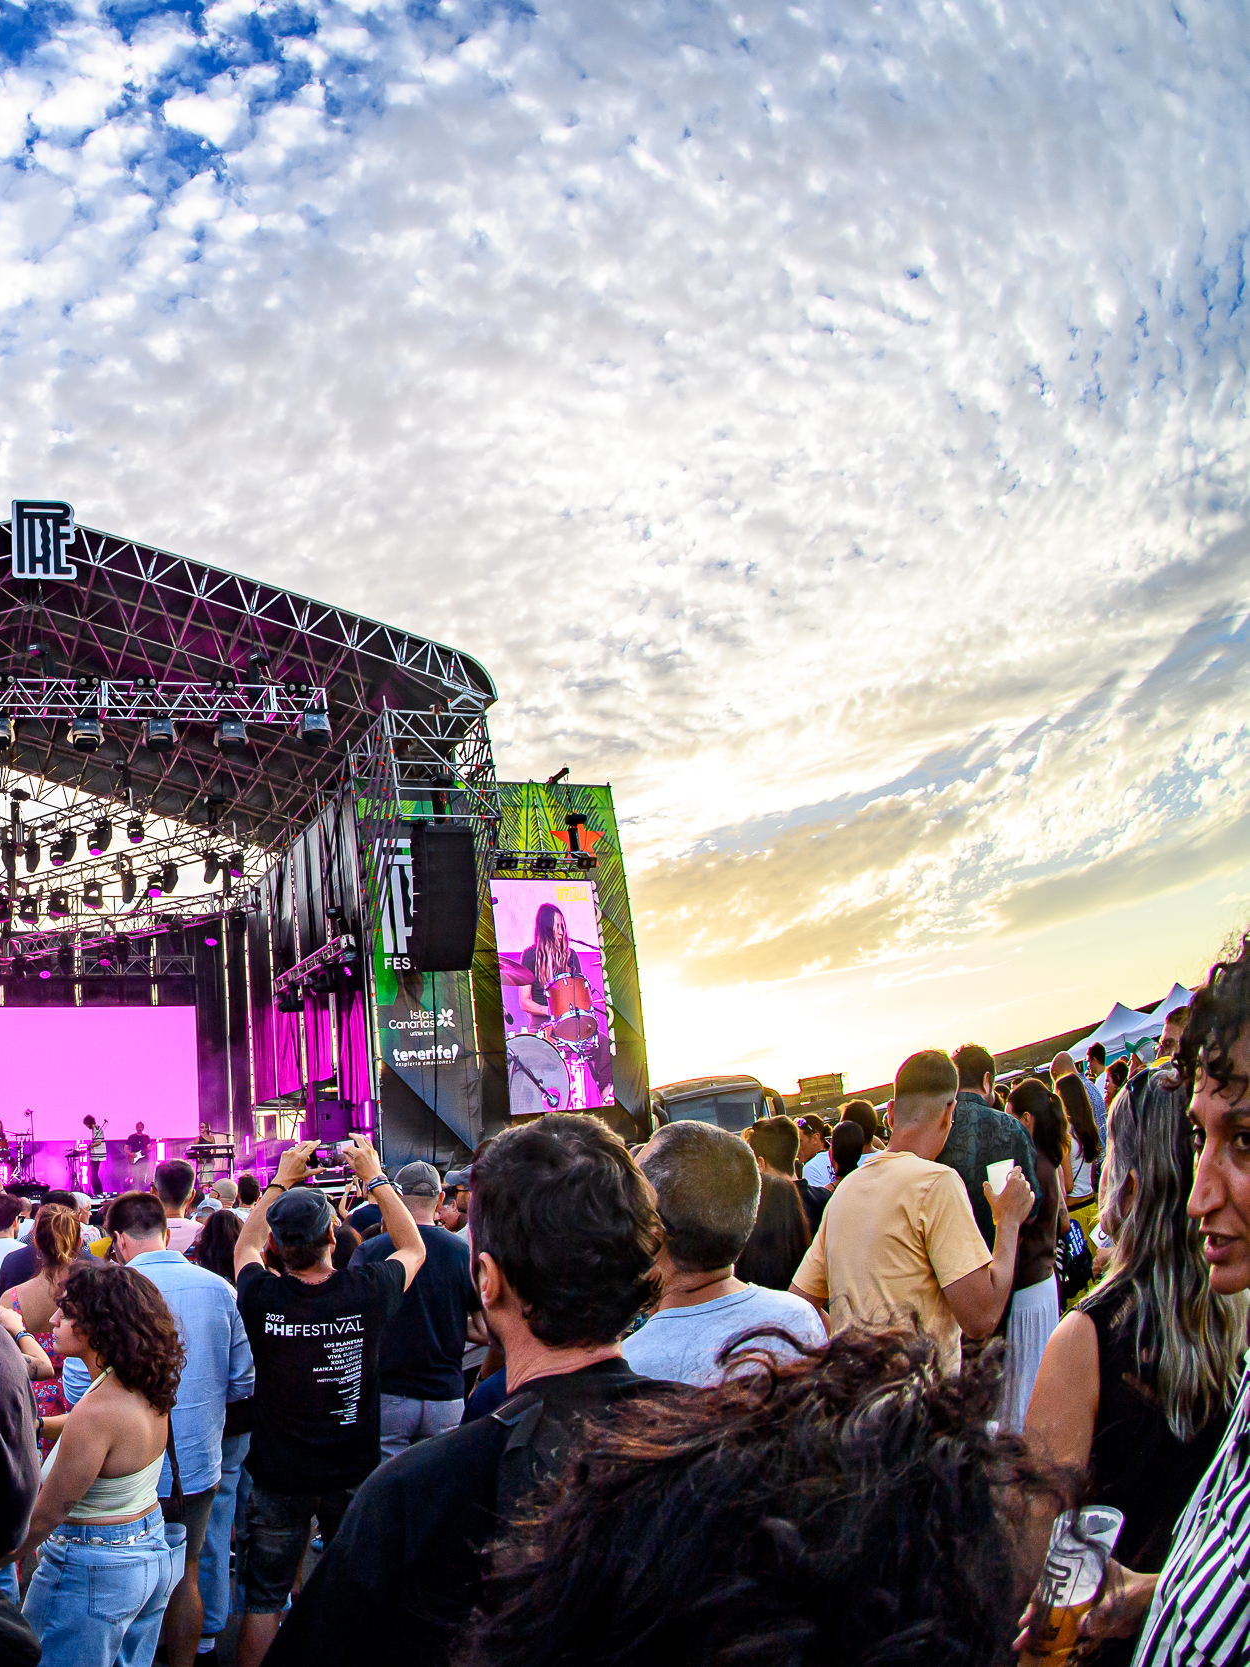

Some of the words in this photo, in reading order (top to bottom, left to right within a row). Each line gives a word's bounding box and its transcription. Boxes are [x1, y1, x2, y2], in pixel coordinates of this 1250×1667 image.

[410, 1009, 435, 1020] Islas
[388, 1019, 436, 1030] Canarias
[265, 1313, 285, 1323] 2022
[264, 1320, 365, 1336] PHEFESTIVAL
